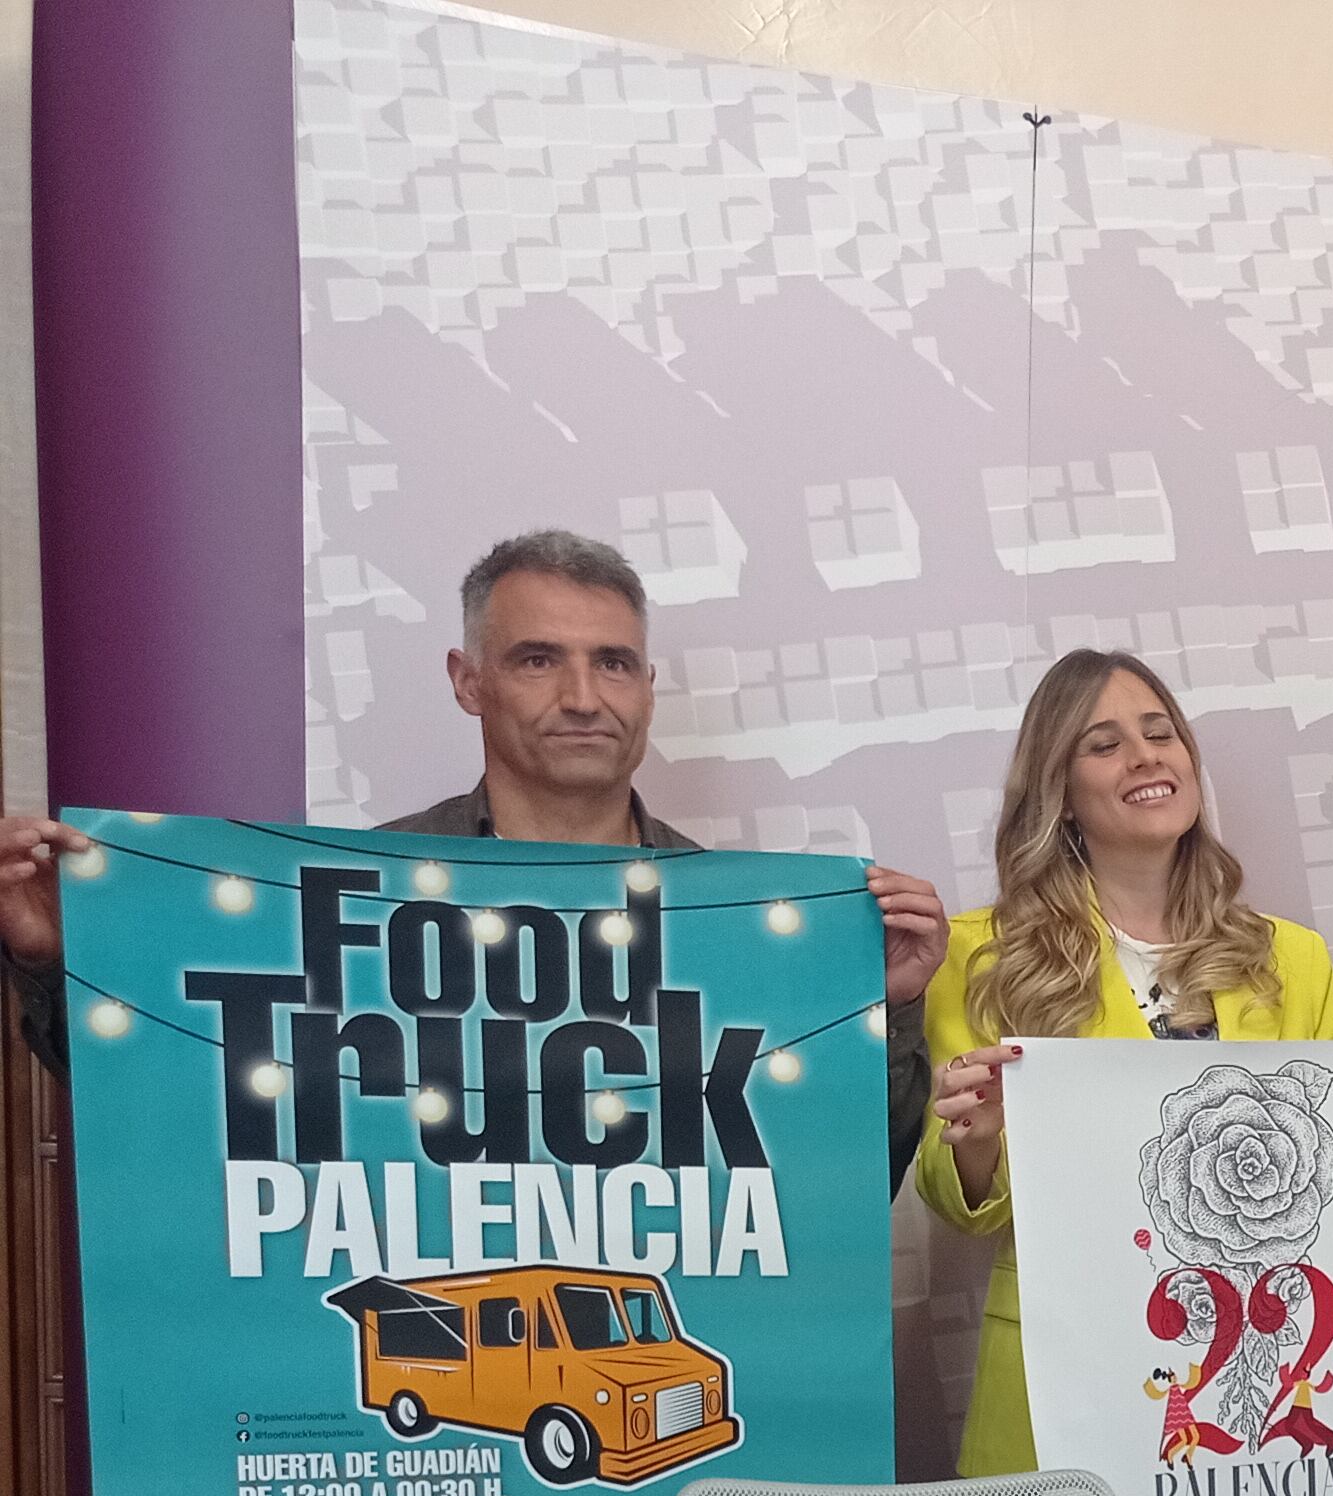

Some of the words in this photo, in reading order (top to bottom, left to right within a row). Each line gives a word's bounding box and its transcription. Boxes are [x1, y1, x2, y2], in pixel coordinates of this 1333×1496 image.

[300, 866, 662, 1026] Food
[185, 970, 770, 1168] Truck
[226, 1160, 789, 1278] PALENCIA
[237, 1453, 337, 1482] HUERTA
[346, 1452, 379, 1479] DE
[386, 1443, 500, 1477] GUADIÁN
